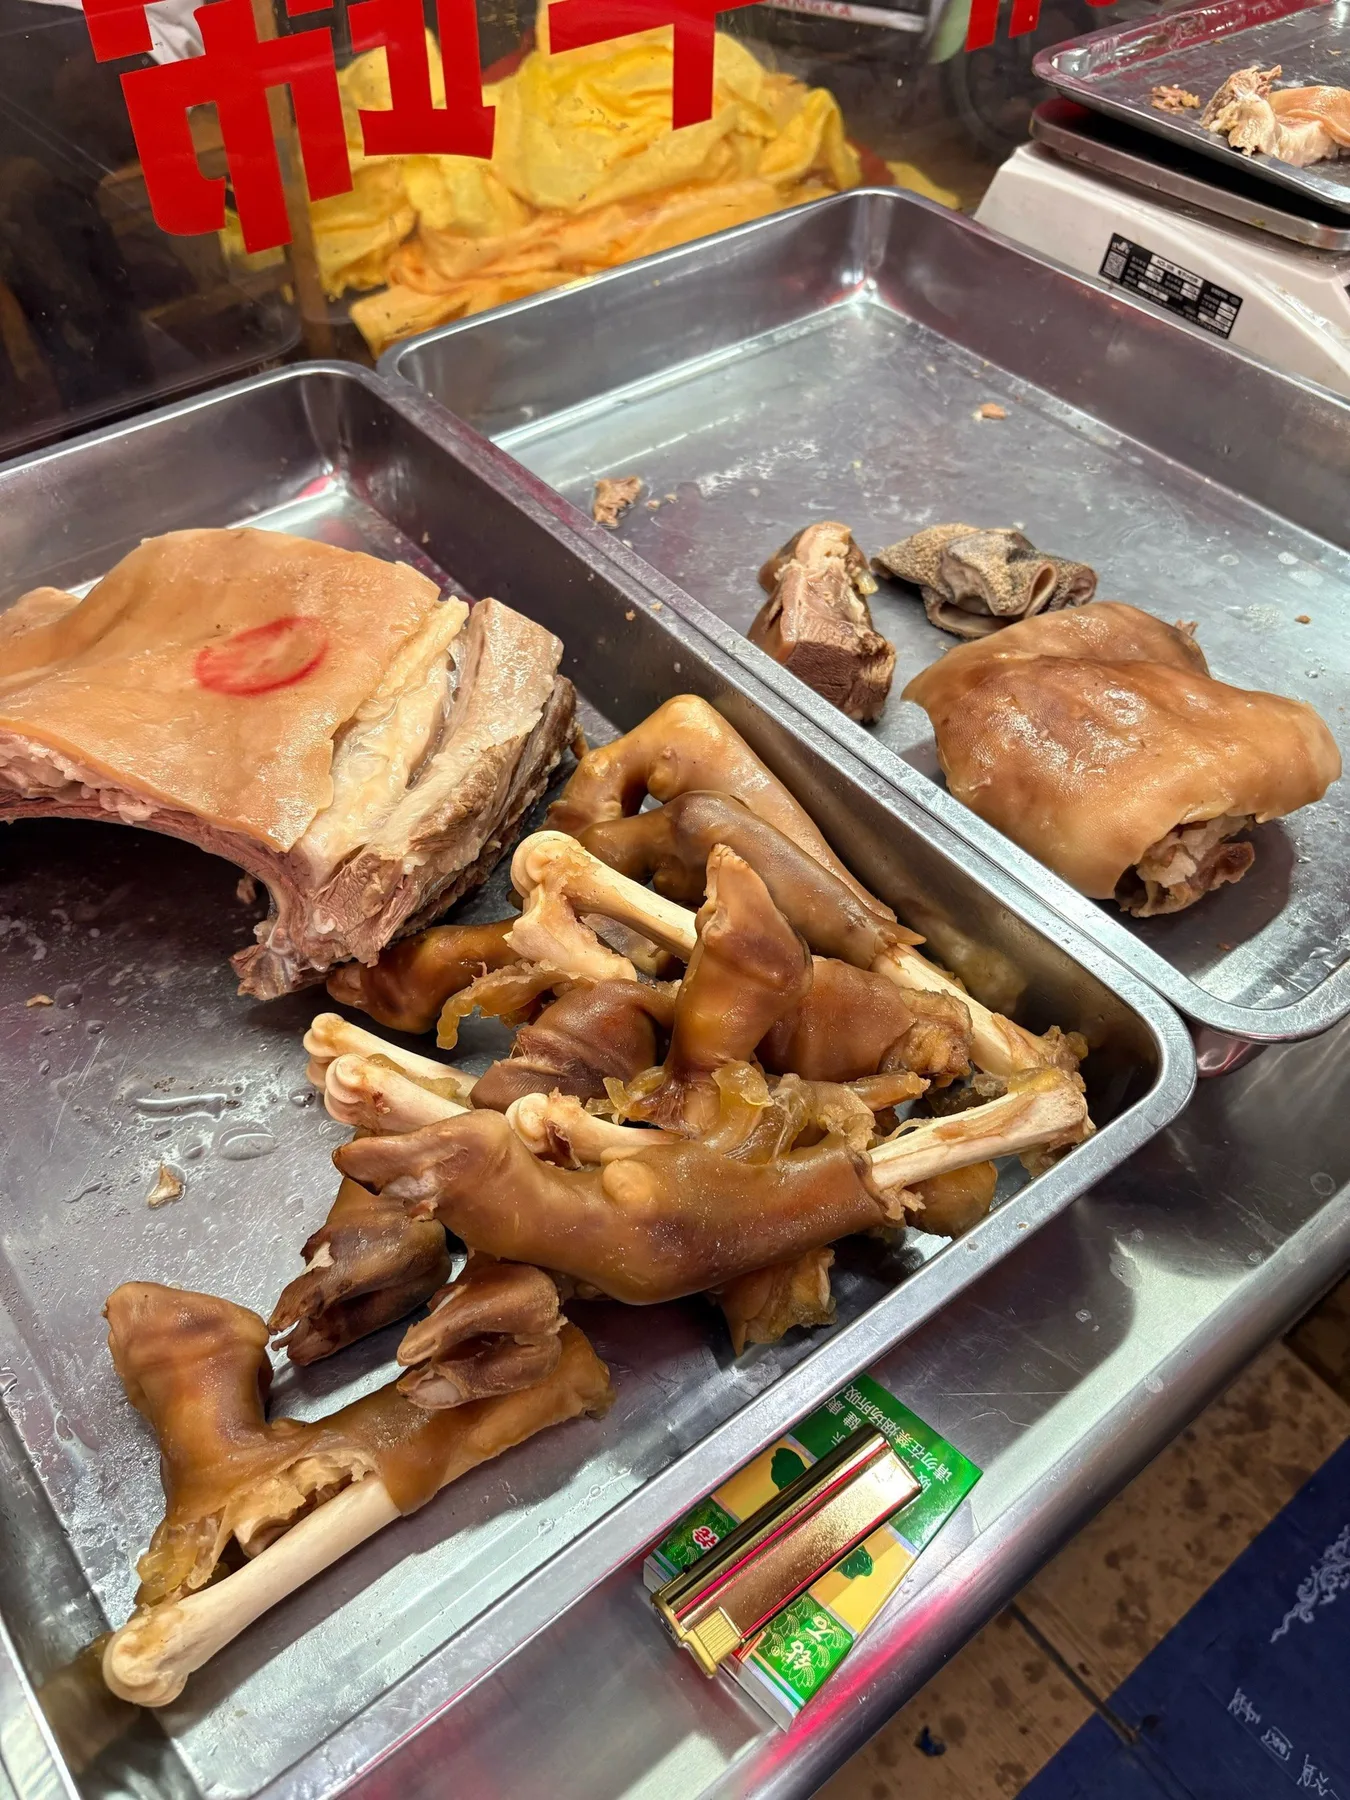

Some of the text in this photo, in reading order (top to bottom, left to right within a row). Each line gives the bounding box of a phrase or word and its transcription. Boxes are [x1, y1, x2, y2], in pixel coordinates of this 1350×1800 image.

[842, 1385, 953, 1485] 请勿在禁烟场所吸
[784, 1615, 835, 1671] 钻石
